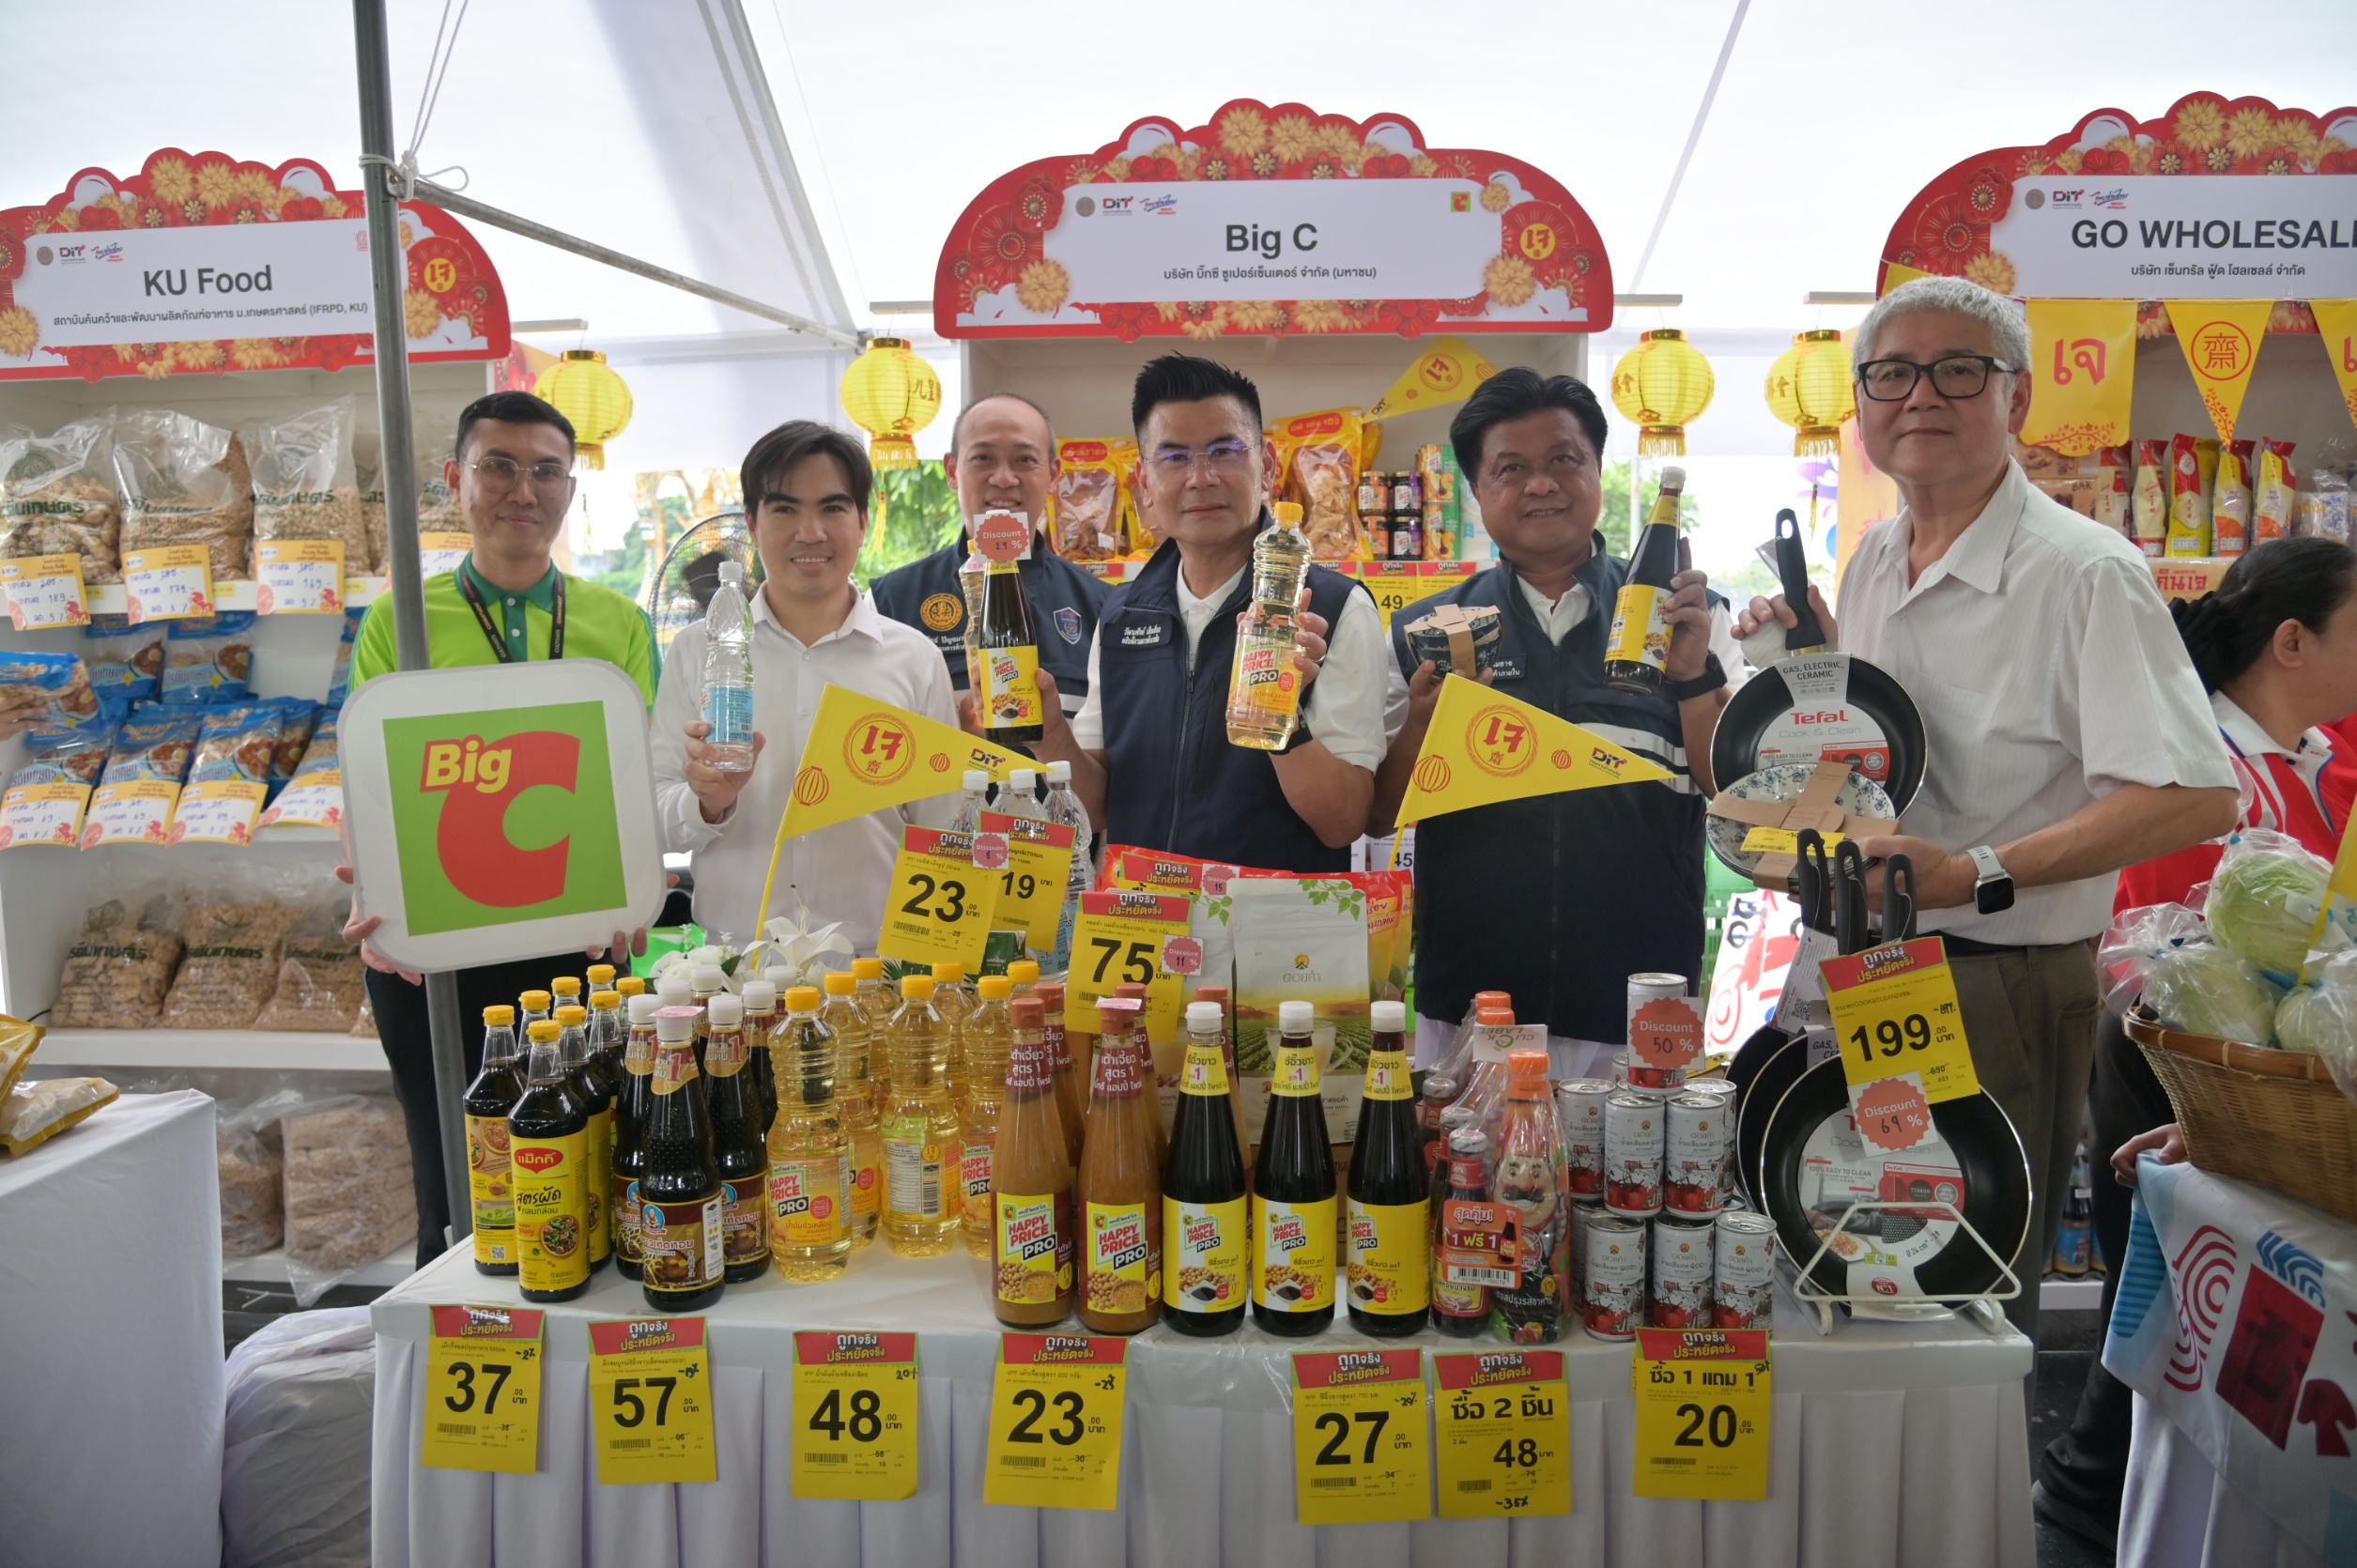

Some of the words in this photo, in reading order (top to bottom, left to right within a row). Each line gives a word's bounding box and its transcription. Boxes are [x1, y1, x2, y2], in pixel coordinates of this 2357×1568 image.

[1225, 223, 1281, 260] Big
[1292, 223, 1317, 252] C
[2072, 220, 2128, 249] GO
[1163, 267, 1194, 280] บริษัท
[1197, 265, 1219, 280] บิ๊กซี
[1301, 266, 1330, 279] จำกัด
[1333, 267, 1377, 280] (มหาชน)
[2132, 263, 2161, 276] บริษัท
[2164, 262, 2204, 276] เซ็นทรัล
[2207, 264, 2226, 280] ฟู้ด
[2276, 264, 2305, 276] จำกัด
[144, 269, 187, 297] KU
[197, 264, 272, 295] Food
[350, 300, 368, 315] KU)
[2053, 338, 2106, 386] เจ
[982, 530, 1022, 540] Discount
[1011, 541, 1023, 549] %
[1381, 594, 1403, 609] 49
[1782, 665, 1802, 674] GAS,
[1803, 661, 1844, 671] ELECTRIC,
[1796, 670, 1833, 680] CERAMIC
[1002, 672, 1019, 682] PRO
[1251, 671, 1277, 684] PRO
[1791, 710, 1848, 725] Tefal
[1779, 728, 1811, 739] Cook
[1814, 728, 1824, 736] &
[1828, 726, 1861, 736] Clean
[971, 748, 1006, 768] DiT
[1593, 747, 1627, 769] DiT
[424, 740, 513, 794] Big
[437, 730, 581, 908] C
[1012, 818, 1046, 832] ถูกจริง
[1154, 862, 1188, 875] ถูกจริง
[1001, 871, 1035, 899] 19
[1040, 879, 1053, 887] บาท
[1147, 872, 1194, 884] ประหยัดจริง
[901, 872, 965, 923] 23
[1119, 893, 1157, 906] ถูกจริง
[965, 910, 980, 918] บาท
[1108, 903, 1162, 916] ประหยัดจริง
[1168, 948, 1199, 958] Discount
[1863, 946, 1904, 969] ถูกจริง
[1091, 937, 1155, 986] 75
[1283, 972, 1321, 983] ดอยคำ
[1856, 958, 1915, 983] ประหยัดจริง
[1639, 1020, 1695, 1033] Discount
[1653, 1037, 1672, 1053] 50
[1679, 1038, 1694, 1053] %
[1850, 1014, 1932, 1062] 199
[1936, 1034, 1955, 1044] บาท
[728, 1035, 743, 1064] 1
[669, 1053, 683, 1083] 1
[1012, 1062, 1033, 1077] สูตร
[1036, 1061, 1041, 1074] 1
[1104, 1067, 1126, 1081] สูตร
[1129, 1066, 1134, 1078] 1
[1194, 1067, 1201, 1081] 1
[1296, 1067, 1302, 1081] 1
[1377, 1070, 1384, 1084] 1
[1863, 1099, 1918, 1118] Discount
[1880, 1116, 1902, 1134] 69
[1906, 1114, 1923, 1128] %
[961, 1156, 990, 1171] HAPPY
[962, 1165, 992, 1180] PRICE
[769, 1175, 798, 1191] HAPPY
[516, 1186, 562, 1211] สูตรผัด
[770, 1185, 801, 1202] PRICE
[521, 1206, 558, 1216] กลมกล่อม
[778, 1199, 808, 1216] PRO
[1454, 1206, 1494, 1224] สุดคุ้ม!
[1009, 1215, 1047, 1236] HAPPY
[1099, 1222, 1138, 1243] HAPPY
[1187, 1222, 1214, 1237] HAPPY
[1272, 1222, 1300, 1237] HAPPY
[1351, 1222, 1371, 1233] HAPPY
[1351, 1228, 1373, 1238] PRICE
[1009, 1224, 1049, 1248] PRICE
[1188, 1228, 1217, 1244] PRICE
[1273, 1228, 1302, 1243] PRICE
[1357, 1238, 1378, 1249] PRO
[1451, 1233, 1458, 1246] 1
[1463, 1233, 1486, 1247] ฟรี
[1488, 1236, 1497, 1249] 1
[1024, 1235, 1055, 1259] PRO
[1101, 1233, 1140, 1255] PRICE
[1196, 1237, 1221, 1252] PRO
[1283, 1237, 1306, 1251] PRO
[1115, 1244, 1146, 1268] PRO
[460, 1322, 514, 1335] ประหยัดจริง
[628, 1320, 669, 1338] ถูกจริง
[621, 1332, 676, 1351] ประหยัดจริง
[837, 1333, 879, 1351] ถูกจริง
[1045, 1335, 1087, 1350] ถูกจริง
[1682, 1331, 1726, 1345] ถูกจริง
[827, 1346, 886, 1363] ประหยัดจริง
[1033, 1348, 1095, 1363] ประหยัดจริง
[1673, 1344, 1736, 1359] ประหยัดจริง
[1337, 1353, 1380, 1371] ถูกจริง
[1479, 1353, 1523, 1375] ถูกจริง
[1328, 1366, 1391, 1385] ประหยัดจริง
[1470, 1366, 1532, 1386] ประหยัดจริง
[1650, 1360, 1675, 1384] ซื้อ
[1683, 1370, 1692, 1385] 1
[1702, 1372, 1737, 1386] แถม
[1746, 1372, 1754, 1387] 1
[445, 1361, 512, 1414] 37
[512, 1396, 528, 1405] บาท
[613, 1376, 676, 1428] 57
[1451, 1390, 1486, 1422] ซื้อ
[1493, 1397, 1513, 1419] 2
[1521, 1386, 1554, 1417] ชิ้น
[683, 1405, 700, 1413] บาท
[809, 1389, 882, 1443] 48
[1007, 1389, 1085, 1446] 23
[1674, 1403, 1737, 1448] 20
[886, 1422, 902, 1430] บาท
[1088, 1424, 1106, 1434] บาท
[1314, 1410, 1390, 1466] 27
[1394, 1440, 1412, 1450] บาท
[1493, 1438, 1537, 1468] 48
